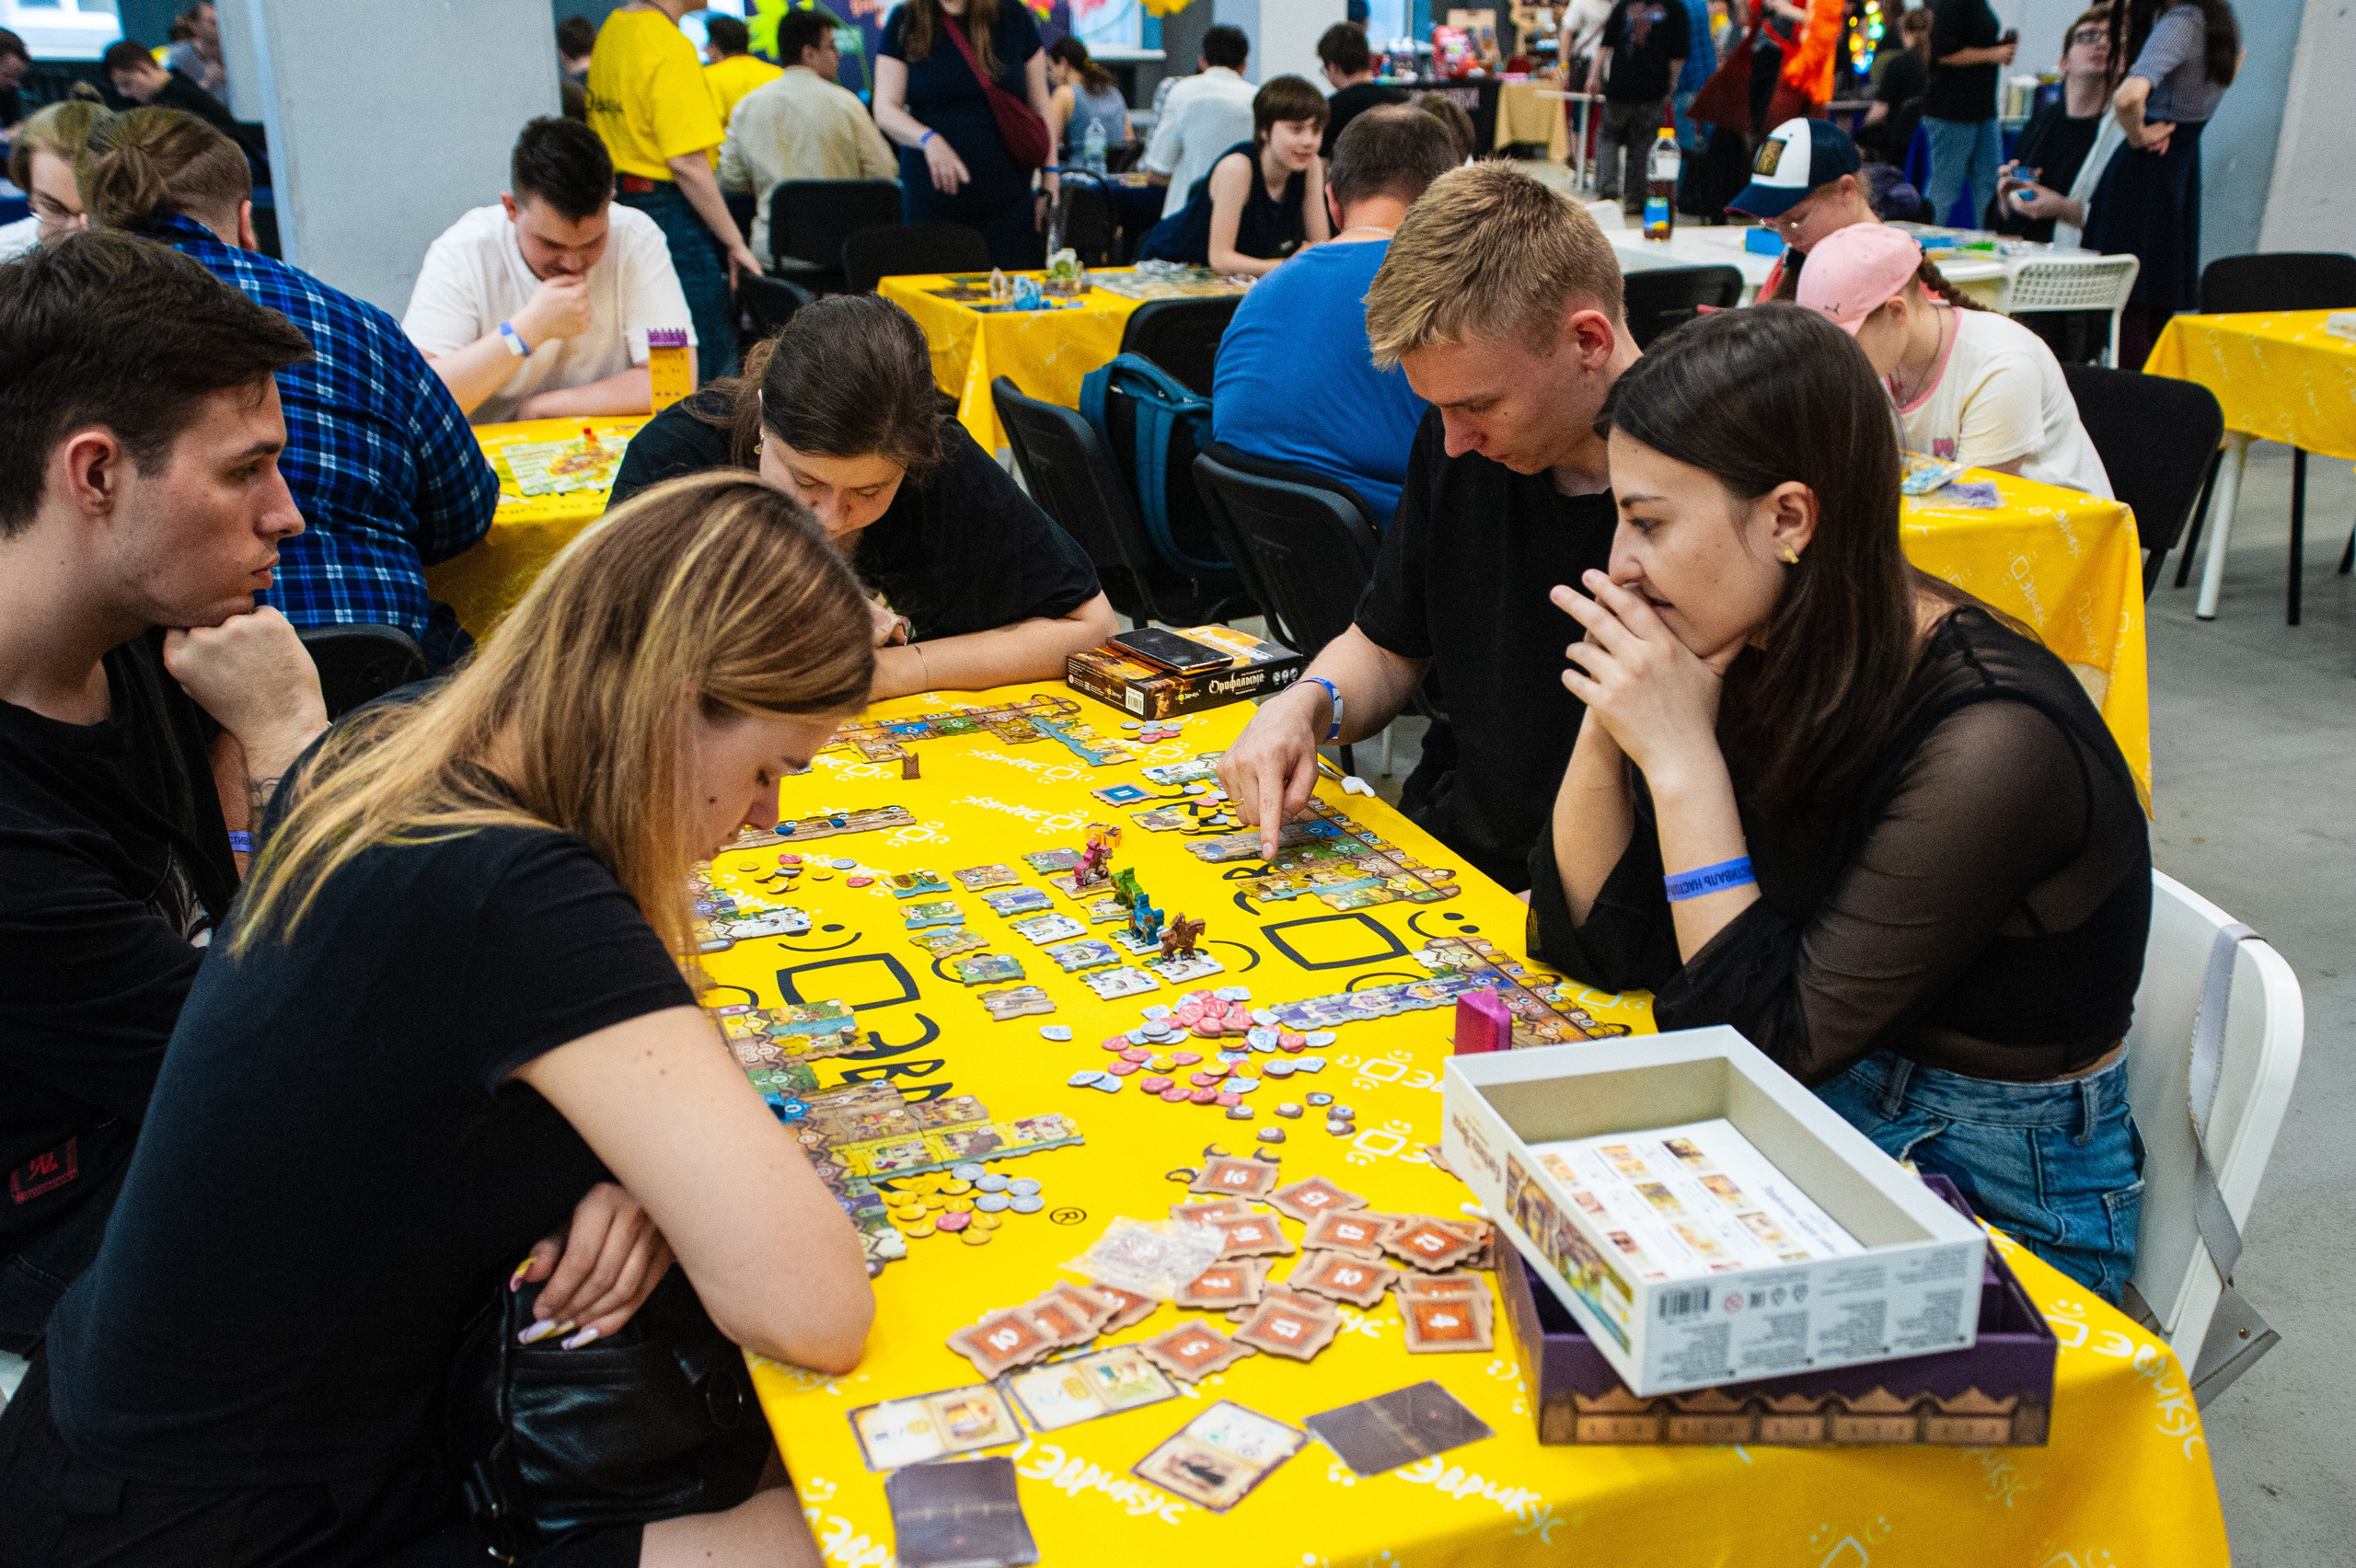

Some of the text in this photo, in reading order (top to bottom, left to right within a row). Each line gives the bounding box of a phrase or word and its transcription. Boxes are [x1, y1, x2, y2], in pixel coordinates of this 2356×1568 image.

[1224, 1170, 1248, 1185] 16
[1334, 1268, 1364, 1286] 10
[988, 1328, 1019, 1351] 10
[1017, 1444, 1188, 1525] Эврикус
[1394, 1454, 1564, 1544] Эврикус
